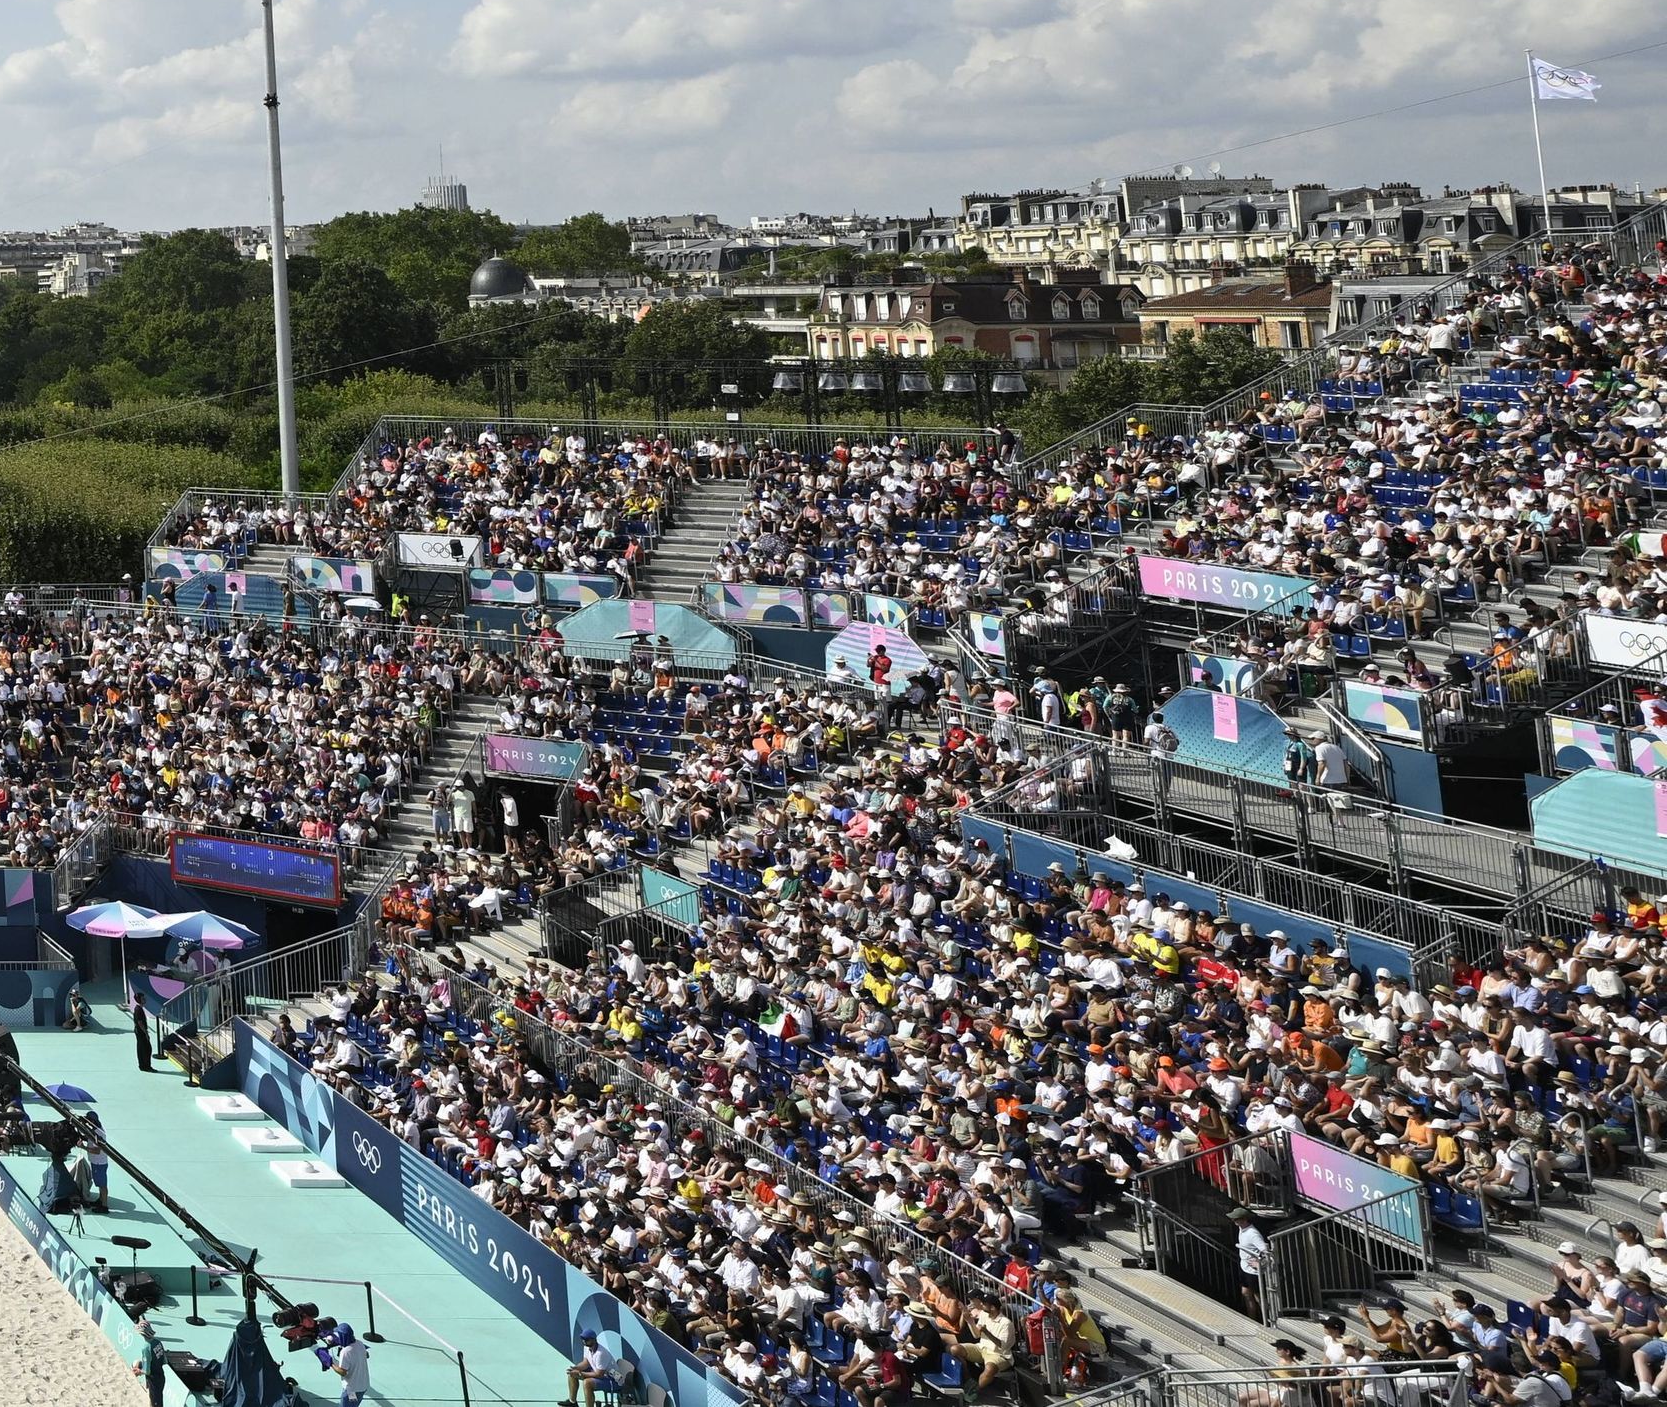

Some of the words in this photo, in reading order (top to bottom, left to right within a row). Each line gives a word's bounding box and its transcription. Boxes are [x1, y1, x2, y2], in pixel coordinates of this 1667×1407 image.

[539, 754, 576, 766] 2024
[267, 850, 274, 861] 3
[488, 1239, 550, 1312] 2024
